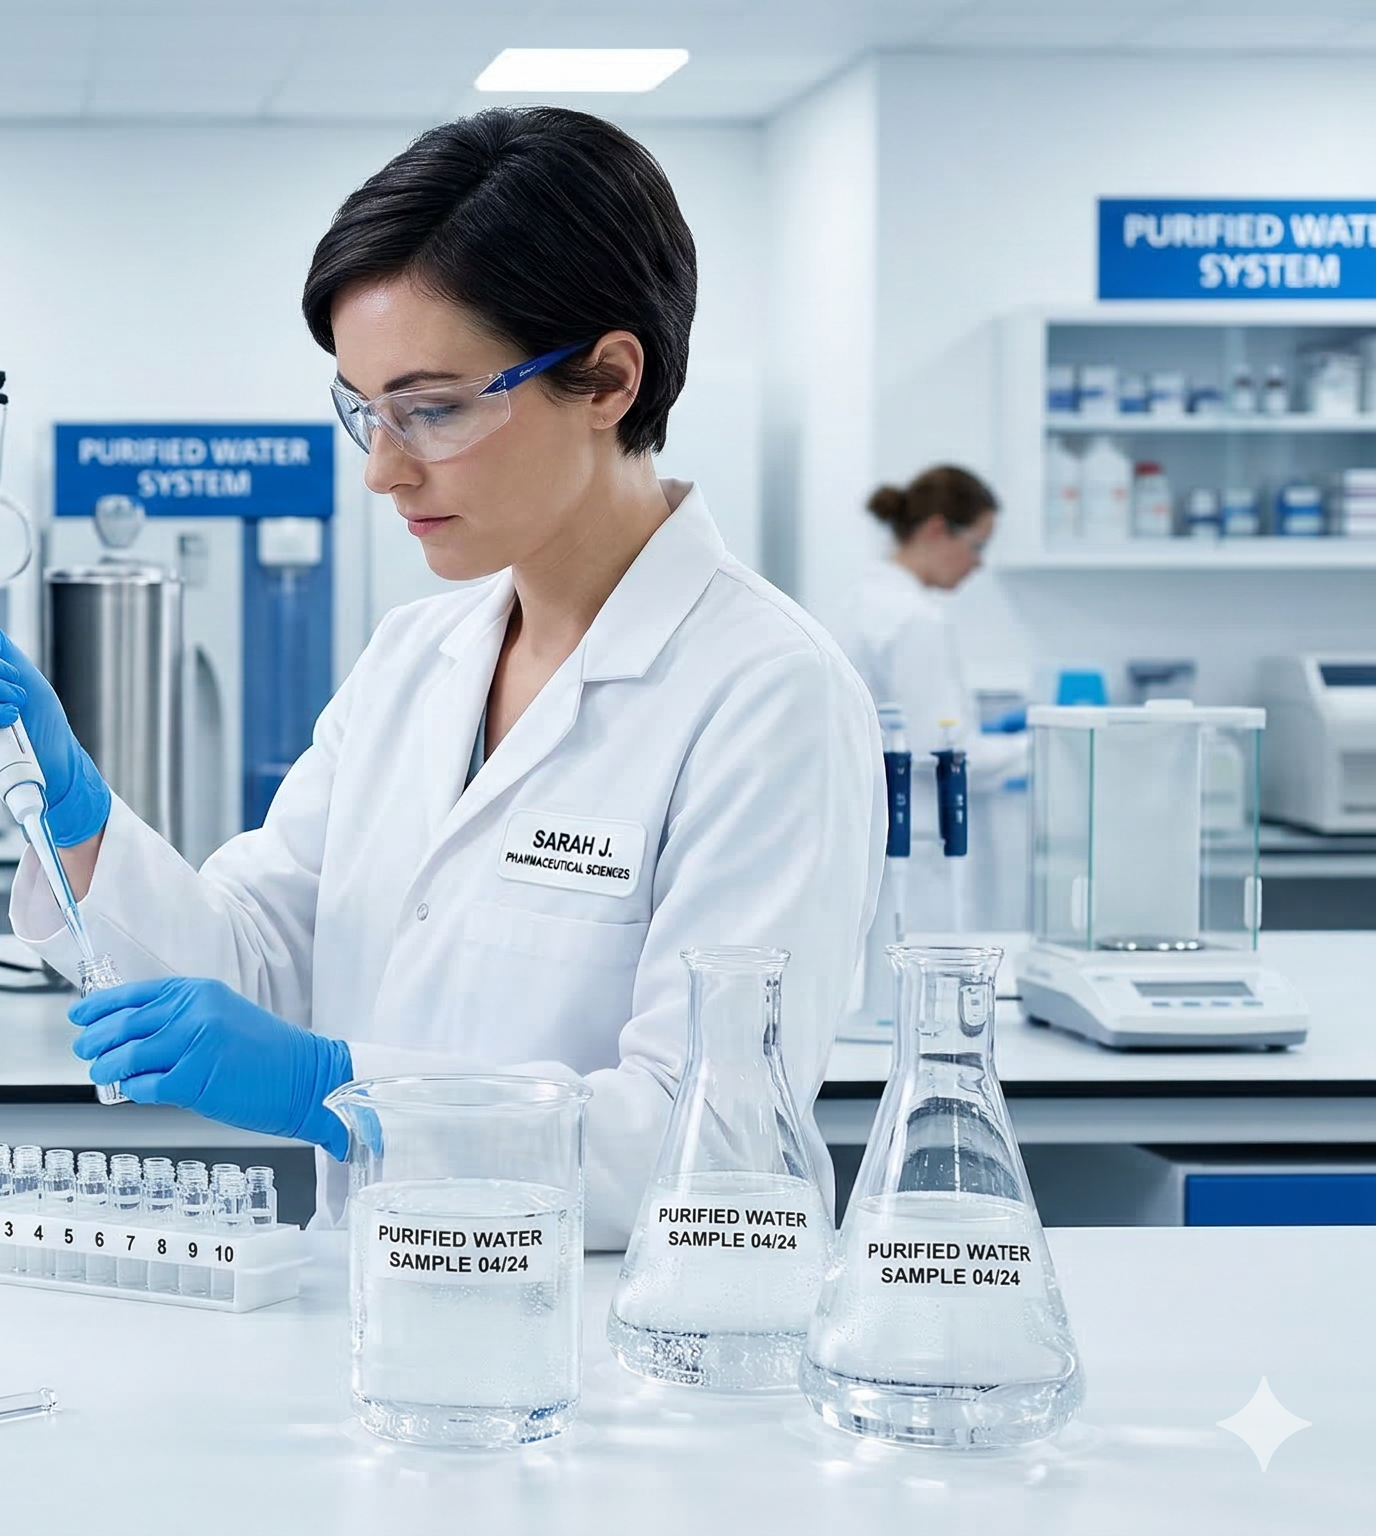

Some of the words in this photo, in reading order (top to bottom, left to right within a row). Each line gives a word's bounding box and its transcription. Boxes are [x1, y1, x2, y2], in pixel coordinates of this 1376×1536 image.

[1123, 213, 1285, 248] PURIFIED
[1199, 253, 1341, 289] SYSTEM
[78, 437, 208, 466] PURIFIED
[209, 437, 310, 466] WATER
[137, 469, 252, 498] SYSTEM
[532, 829, 595, 856] SARAH
[598, 837, 613, 858] J.
[658, 1207, 740, 1225] PURIFIED
[744, 1209, 808, 1228] WATER
[4, 1220, 14, 1238] 3
[33, 1224, 44, 1241] 4
[64, 1228, 74, 1245] 5
[94, 1231, 105, 1248] 6
[126, 1234, 136, 1251] 7
[157, 1238, 167, 1255] 8
[188, 1241, 198, 1259] 9
[214, 1244, 234, 1263] 10
[378, 1224, 467, 1248] PURIFIED
[472, 1229, 543, 1249] WATER
[668, 1230, 745, 1248] SAMPLE
[750, 1233, 798, 1250] 04/24
[389, 1251, 472, 1273] SAMPLE
[478, 1255, 529, 1273] 04/24
[868, 1242, 961, 1260] PURIFIED
[966, 1243, 1032, 1262] WATER
[880, 1267, 967, 1285] SAMPLE
[972, 1268, 1021, 1286] 04/24
